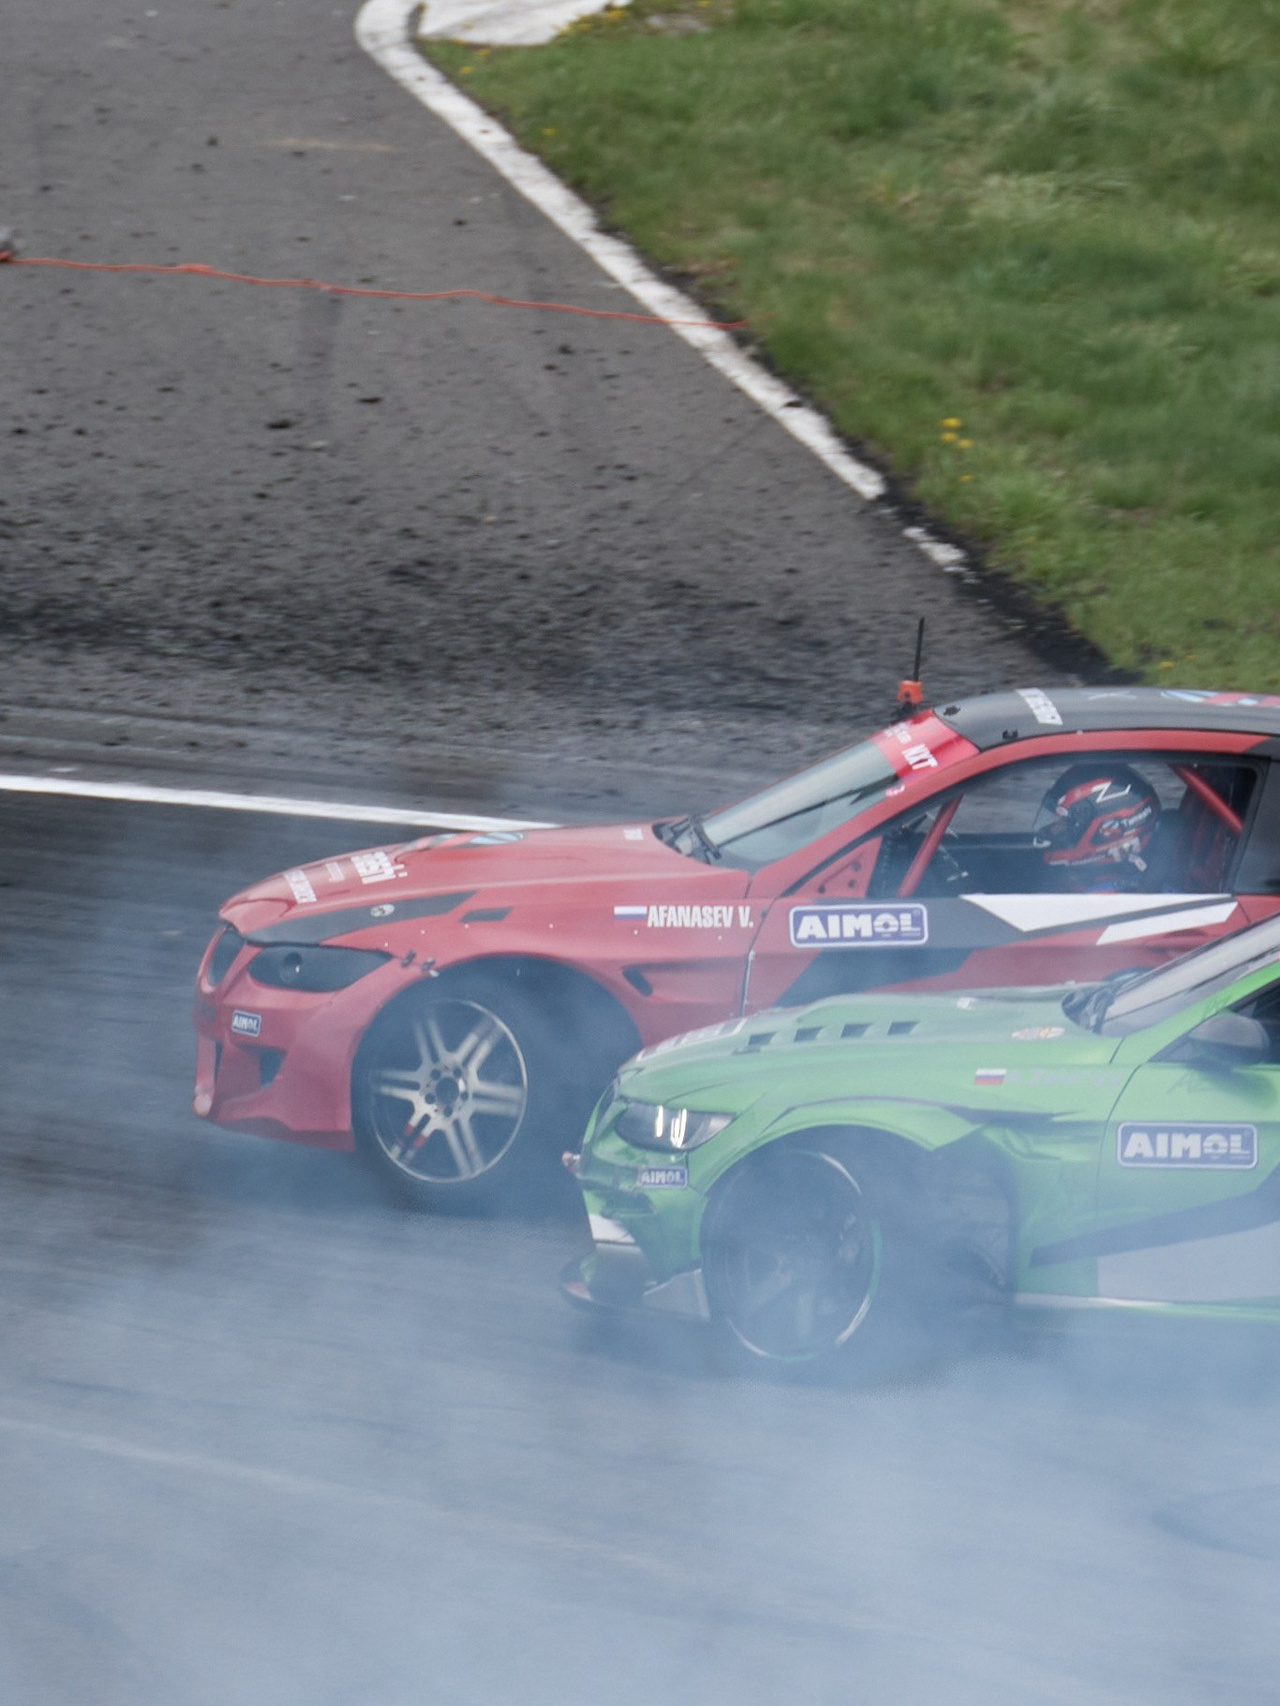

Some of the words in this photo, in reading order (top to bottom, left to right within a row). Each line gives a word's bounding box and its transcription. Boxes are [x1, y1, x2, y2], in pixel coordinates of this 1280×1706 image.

[647, 905, 734, 928] AFANASEV
[738, 905, 754, 928] V.
[796, 912, 921, 940] AIMOL
[1123, 1132, 1251, 1160] AIMOL
